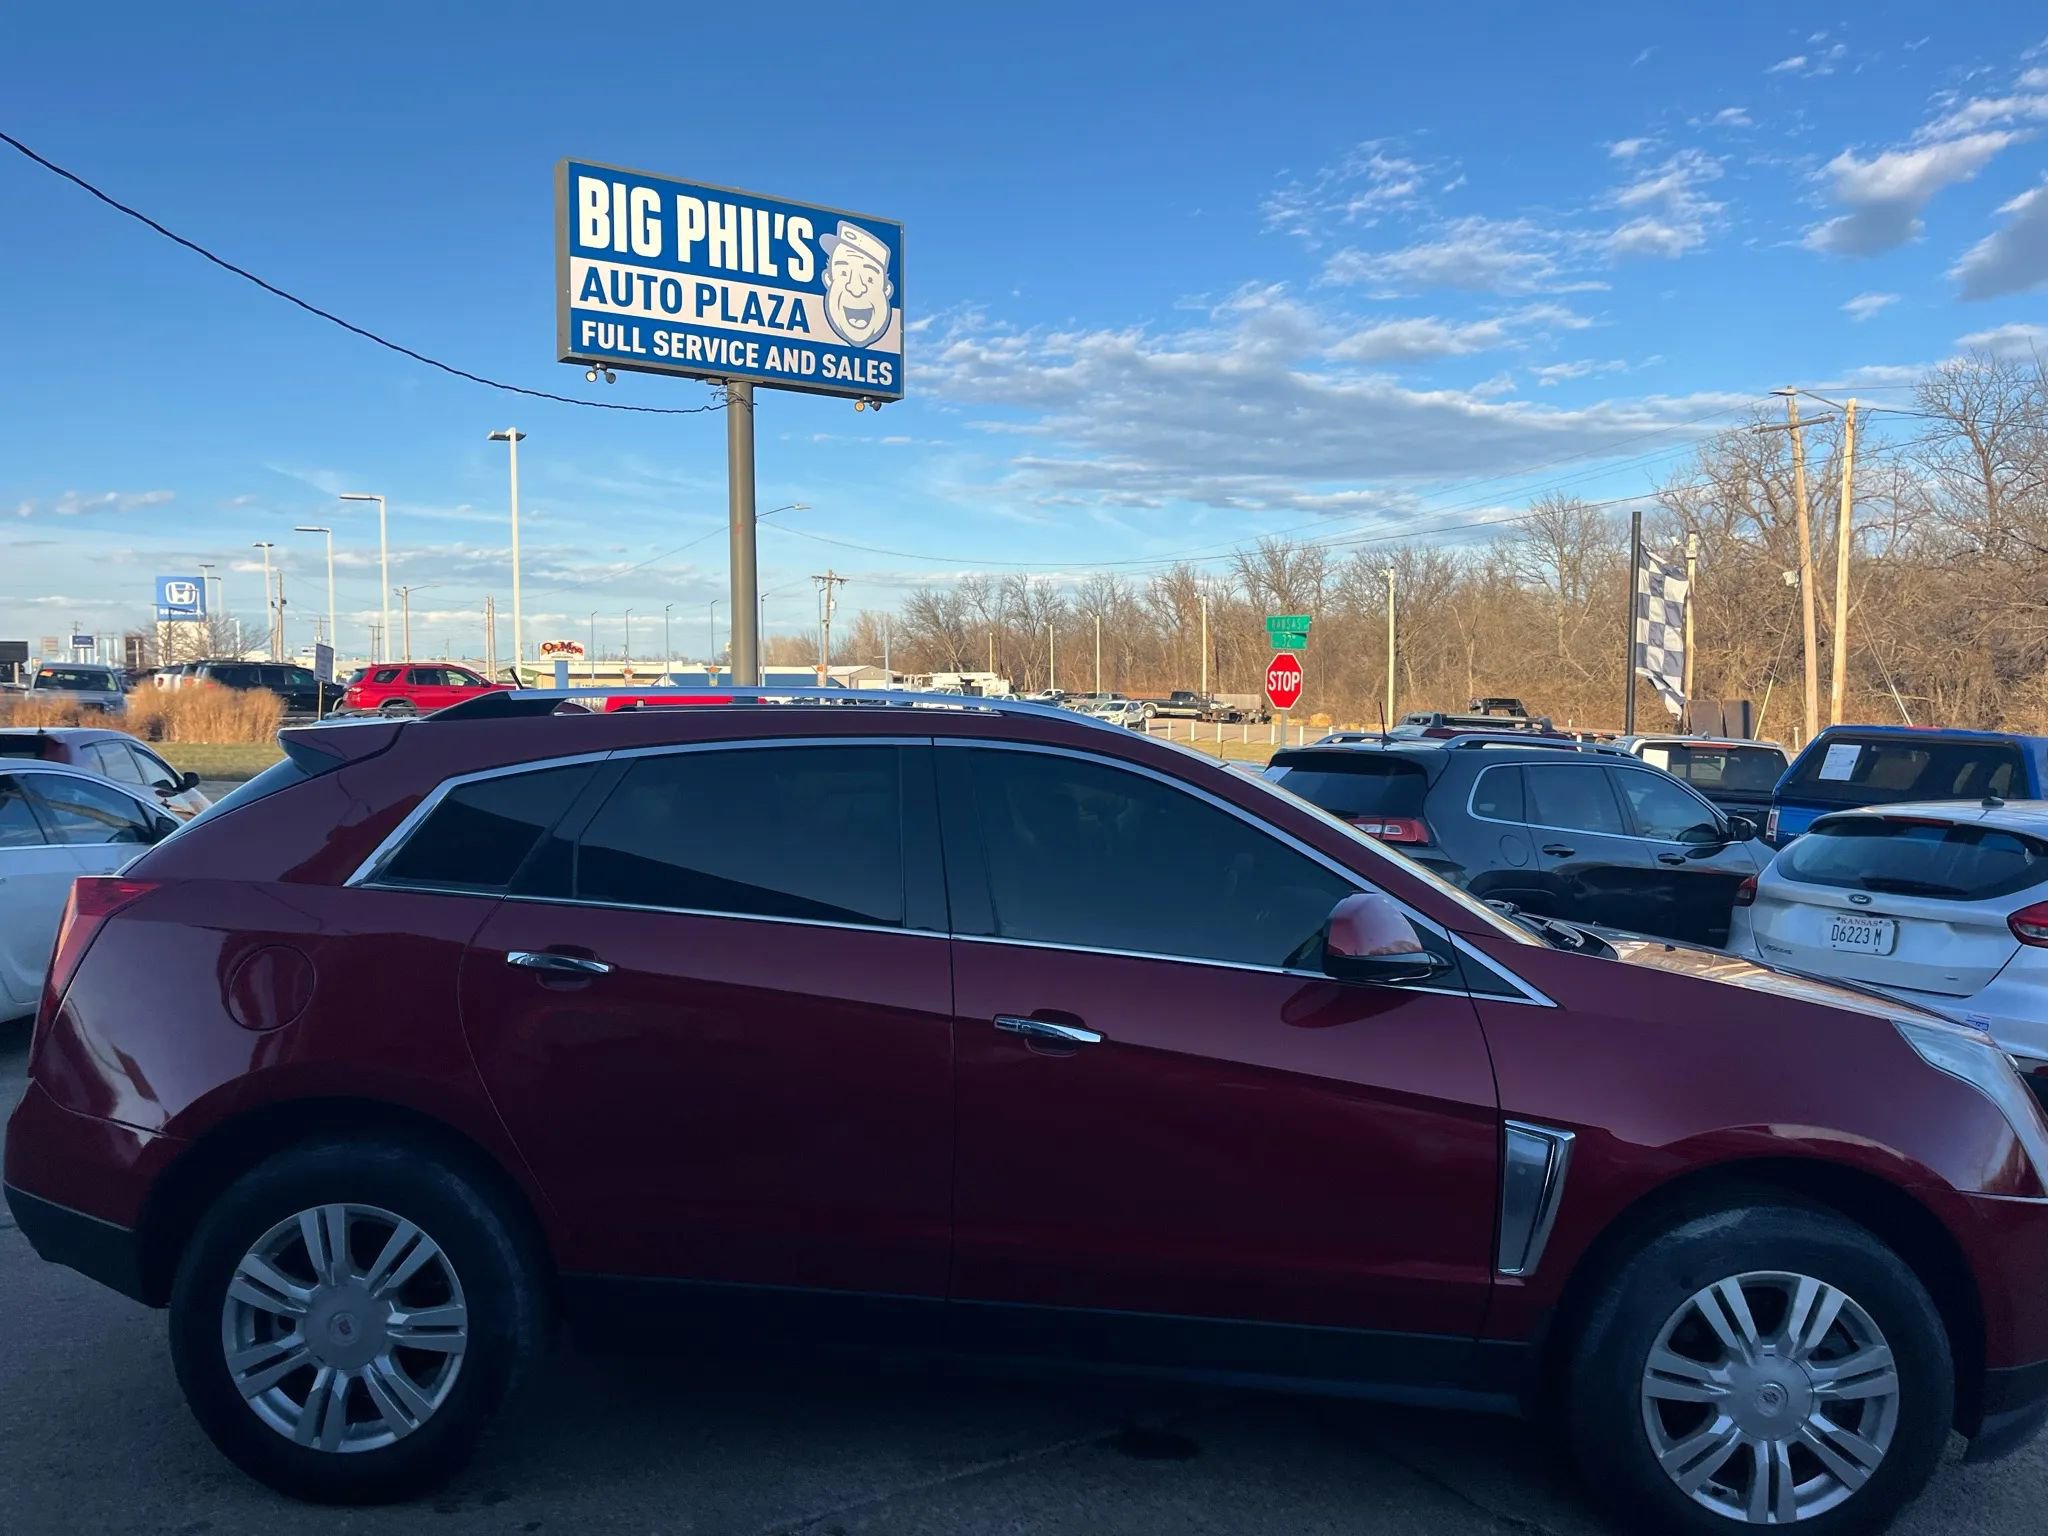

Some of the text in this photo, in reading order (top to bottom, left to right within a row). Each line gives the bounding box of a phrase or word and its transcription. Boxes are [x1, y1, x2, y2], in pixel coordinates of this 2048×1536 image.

[578, 175, 815, 283] BIG PHIL'S
[579, 266, 811, 334] AUTO PLAZA
[581, 320, 893, 386] FULL SERVICE AND SALES
[1268, 671, 1300, 692] STOP
[1831, 924, 1882, 946] D6223 M
[1840, 917, 1878, 927] KANSAS
